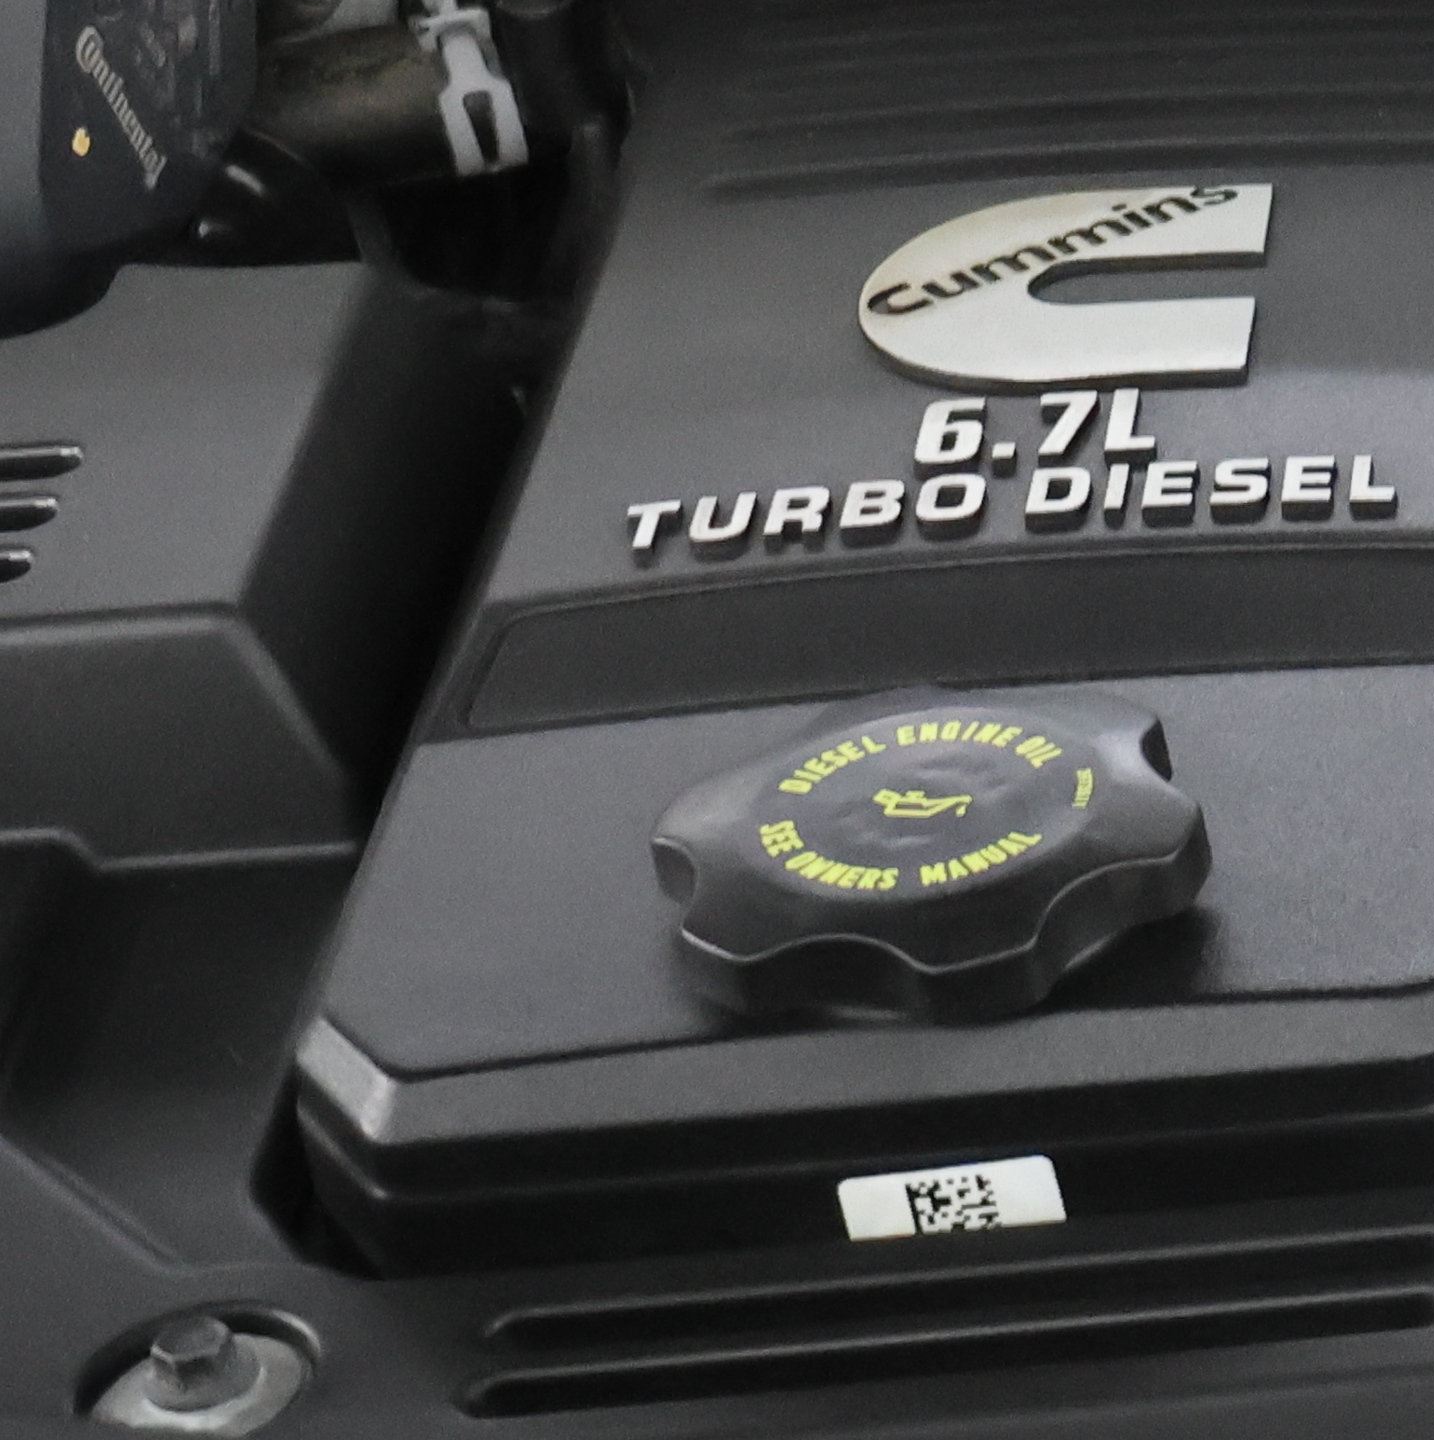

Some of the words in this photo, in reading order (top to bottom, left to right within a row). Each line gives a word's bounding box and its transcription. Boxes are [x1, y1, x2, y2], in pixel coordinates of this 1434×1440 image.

[75, 24, 169, 192] Continental
[868, 184, 1240, 317] Cummins
[914, 388, 1157, 466] 6.7L
[626, 475, 988, 550] TURBO
[1025, 454, 1397, 524] DIESEL
[779, 735, 886, 795] DIESEL
[896, 720, 1022, 749] ENGINE
[1014, 735, 1062, 770] OIL
[760, 820, 805, 857] SEE
[785, 850, 899, 891] OWNERS
[918, 831, 1042, 887] MANUAL
